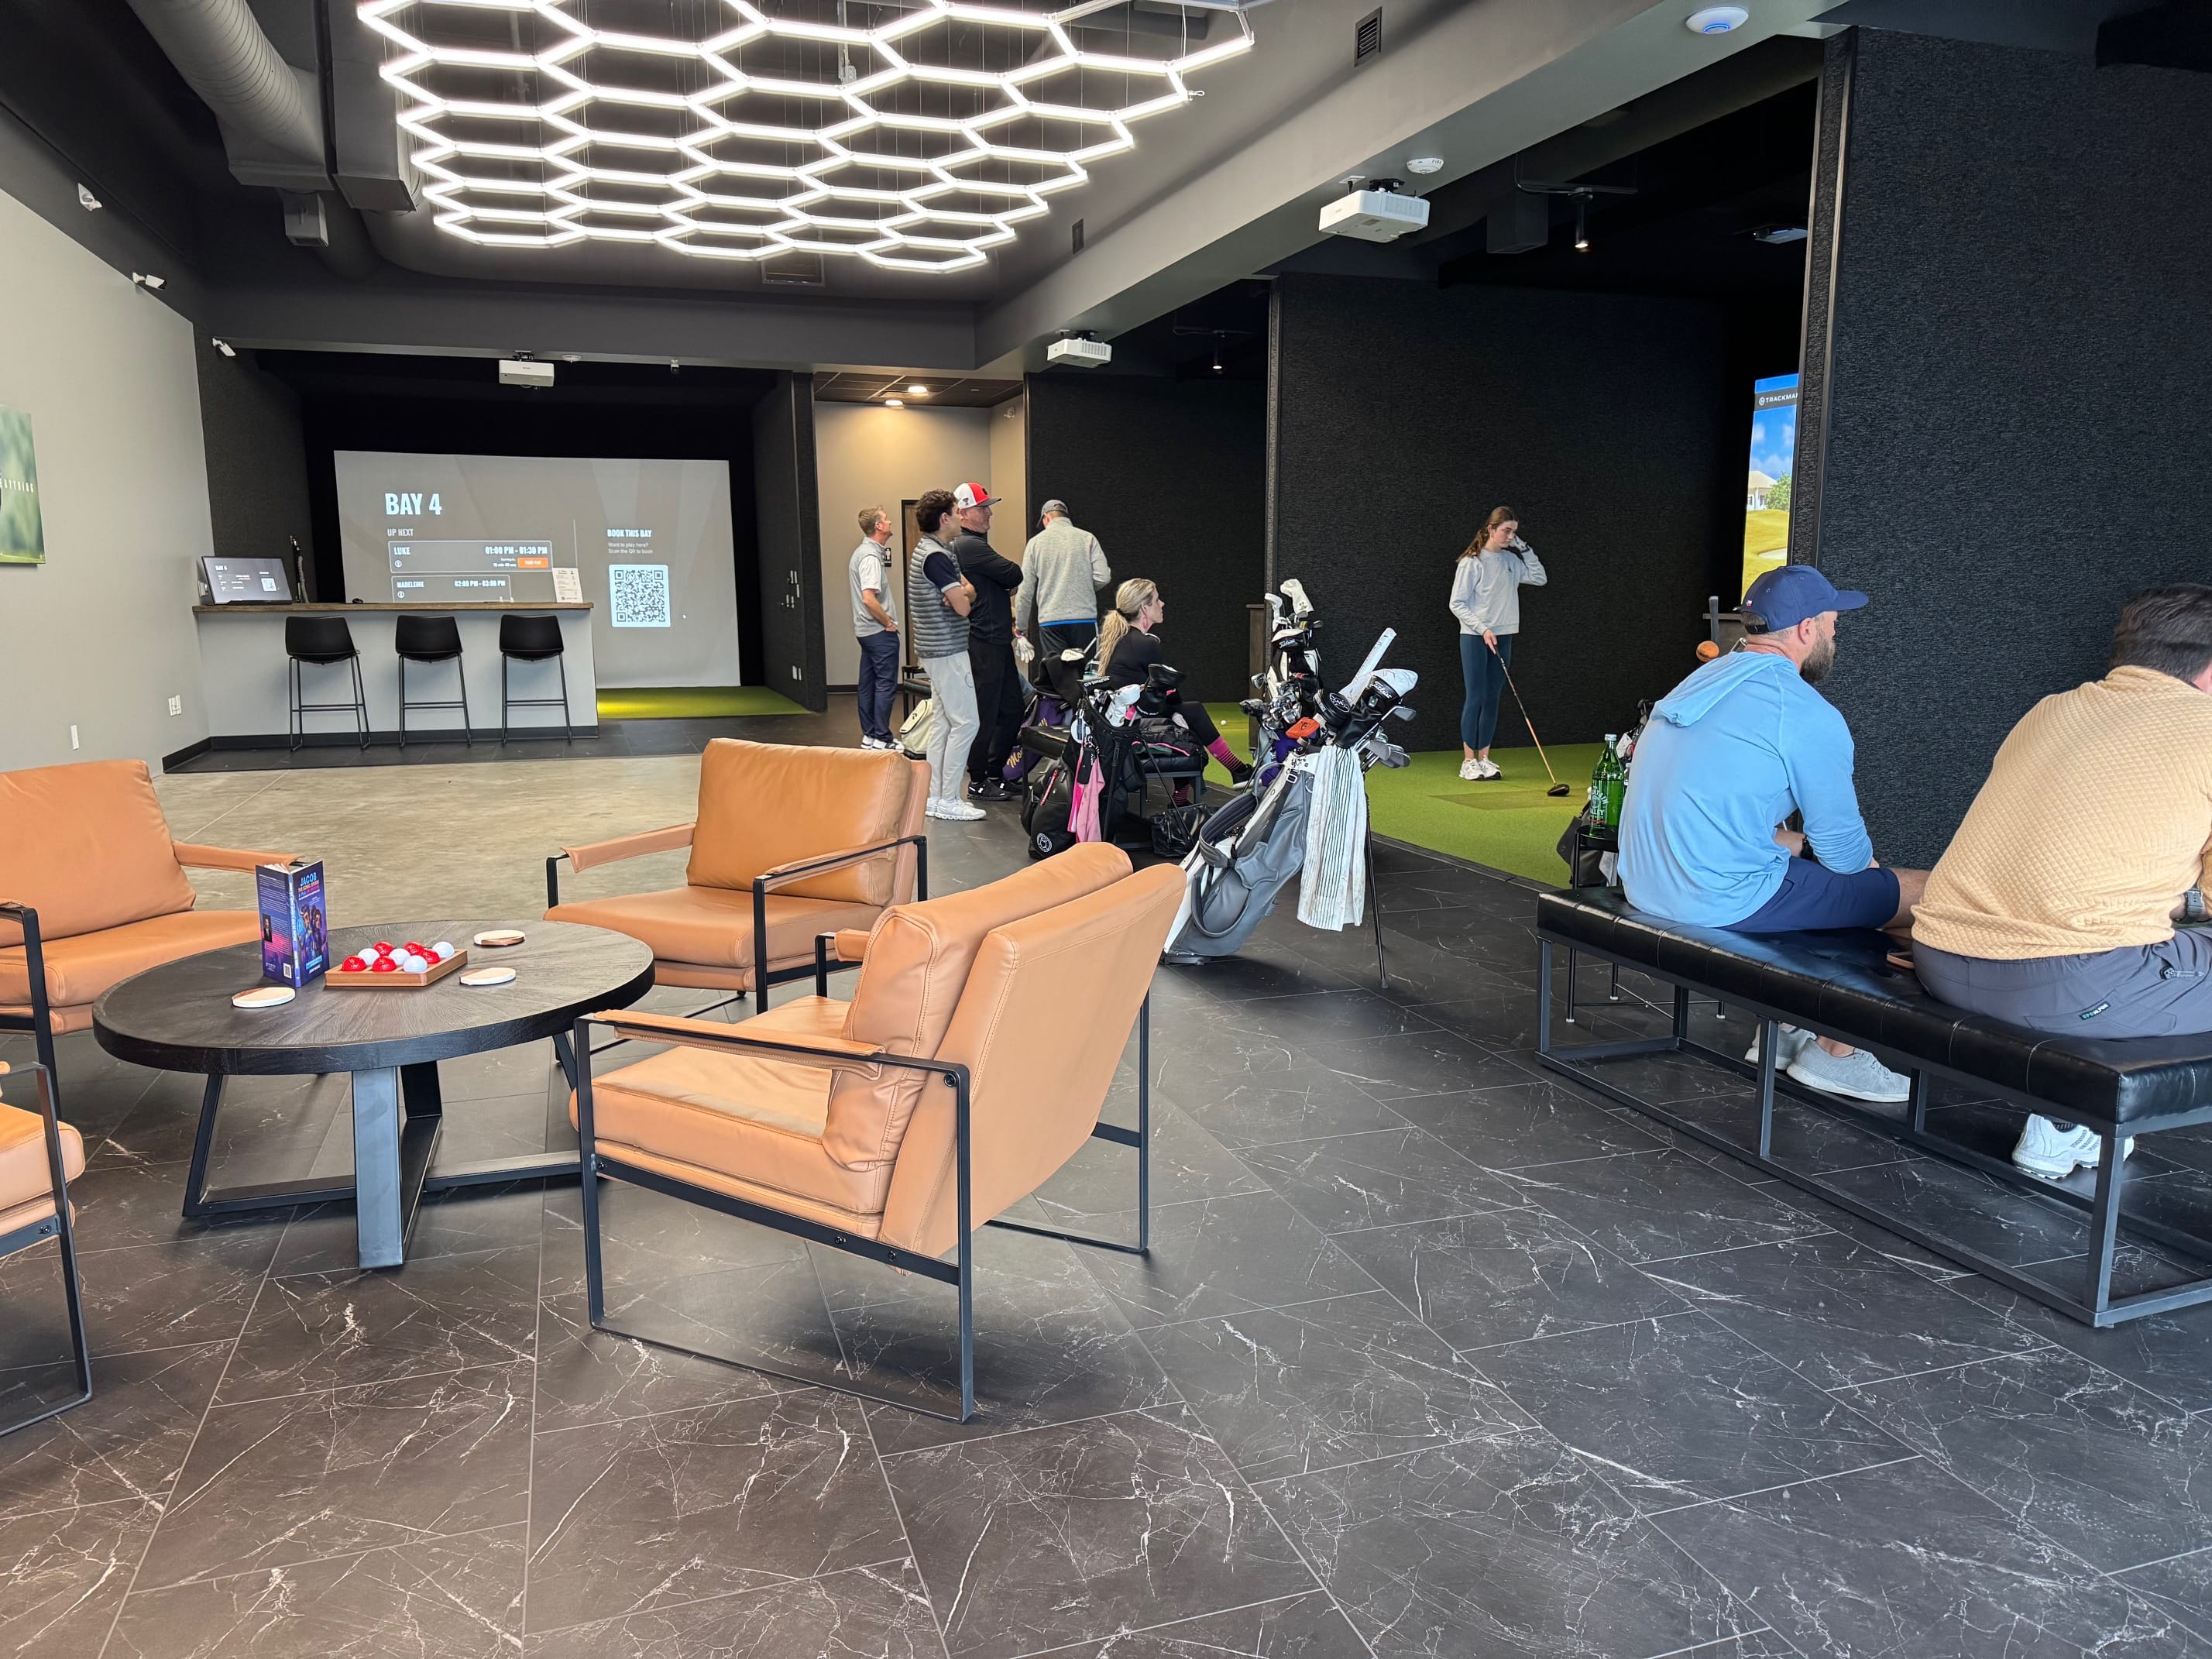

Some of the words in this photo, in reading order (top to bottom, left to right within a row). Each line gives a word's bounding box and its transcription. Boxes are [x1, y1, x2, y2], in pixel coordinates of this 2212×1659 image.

[385, 493, 423, 515] BAY
[429, 493, 442, 515] 4
[393, 547, 411, 555] LUKE
[300, 871, 318, 888] JACOB
